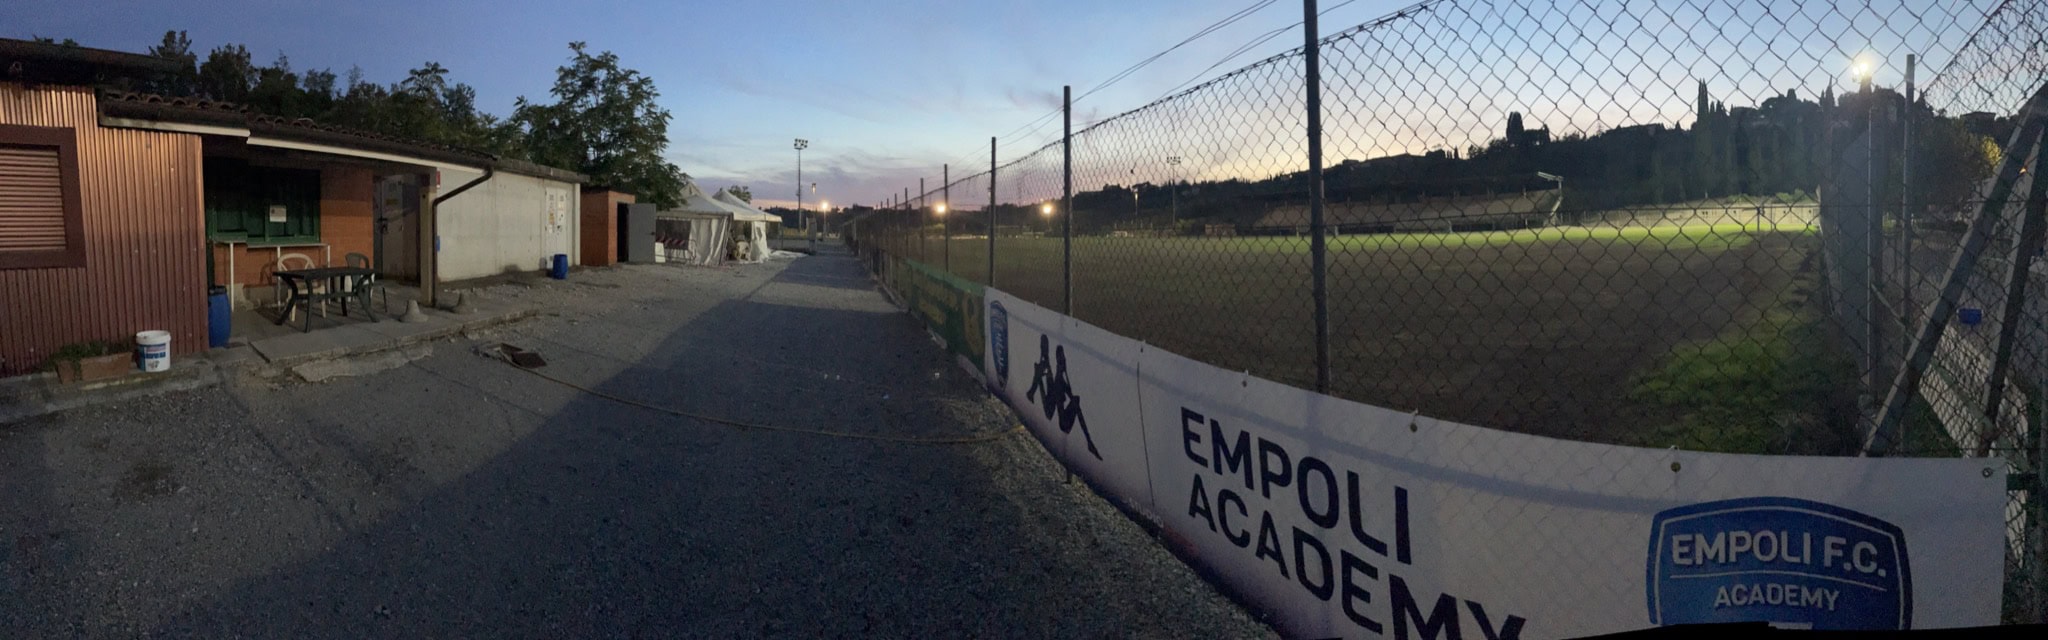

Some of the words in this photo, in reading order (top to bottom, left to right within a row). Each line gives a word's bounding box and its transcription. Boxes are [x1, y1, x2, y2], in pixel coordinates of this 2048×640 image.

[1181, 406, 1412, 565] EMPOLI
[1671, 530, 1811, 566] EMPOLI
[1824, 536, 1887, 577] F.C.
[1714, 583, 1840, 611] ACADEMY
